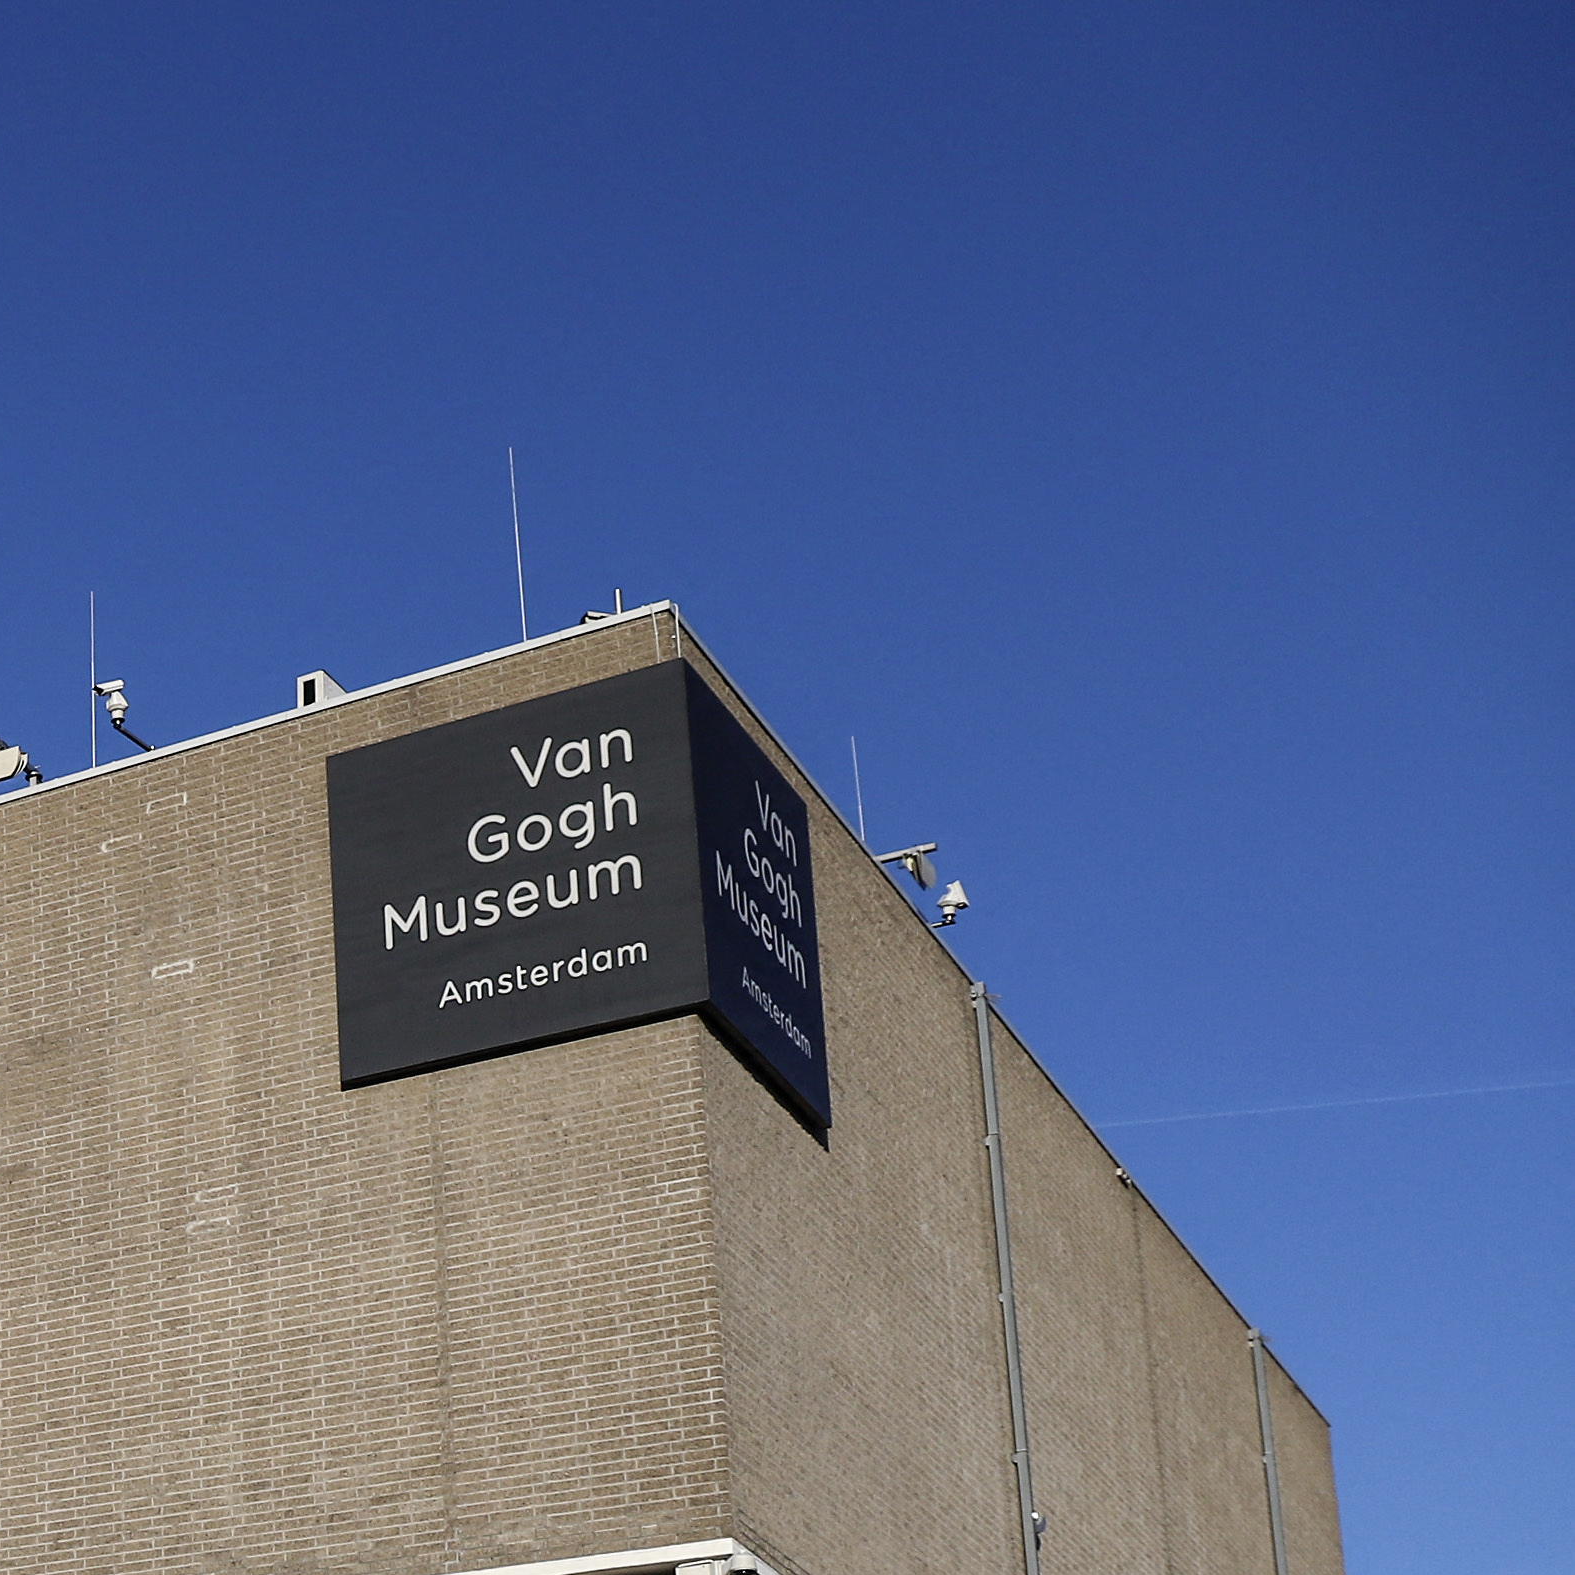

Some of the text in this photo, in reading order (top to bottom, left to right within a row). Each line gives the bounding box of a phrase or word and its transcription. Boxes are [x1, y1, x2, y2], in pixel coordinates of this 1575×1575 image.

[510, 727, 634, 789] Van
[467, 783, 639, 864] Gogh
[754, 780, 799, 868] Van
[383, 854, 643, 951] Museum
[715, 850, 808, 990] Museum
[743, 828, 803, 929] Gogh
[438, 940, 649, 1010] Amsterdam
[741, 966, 813, 1060] Amsterdam
